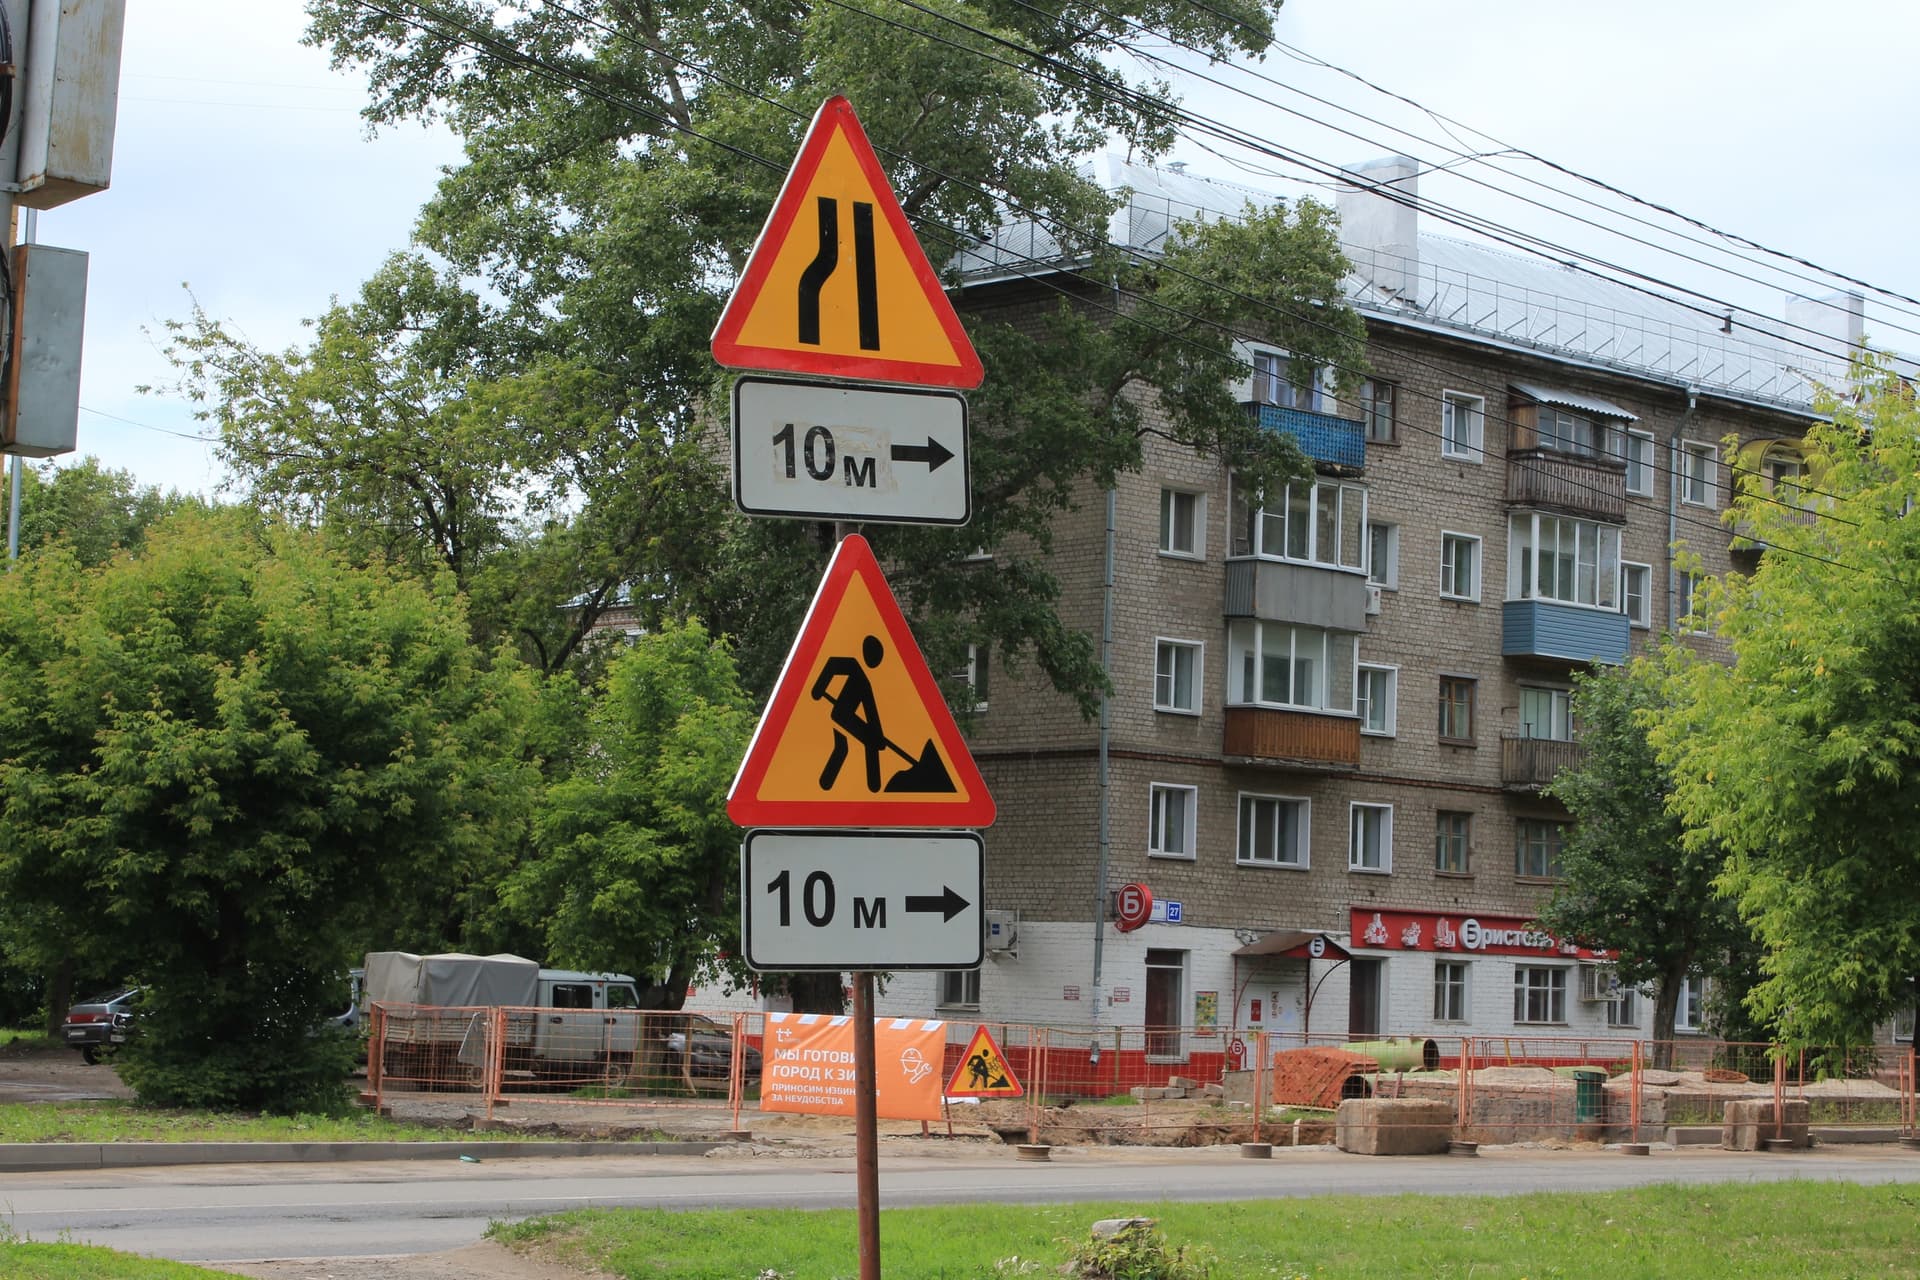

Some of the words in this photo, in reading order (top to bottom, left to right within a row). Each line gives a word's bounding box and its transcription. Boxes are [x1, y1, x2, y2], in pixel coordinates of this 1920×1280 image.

[767, 870, 836, 927] 10
[1124, 891, 1140, 914] Б
[1169, 907, 1179, 917] 27
[774, 1048, 800, 1061] МЫ
[803, 1049, 856, 1064] ГОТОВИ
[772, 1064, 821, 1081] ГОРОД
[825, 1068, 834, 1080] К
[772, 1083, 824, 1094] ПРИНОСИМ
[771, 1093, 783, 1102] ЗА
[785, 1094, 844, 1105] НЕУДОБСТВА
